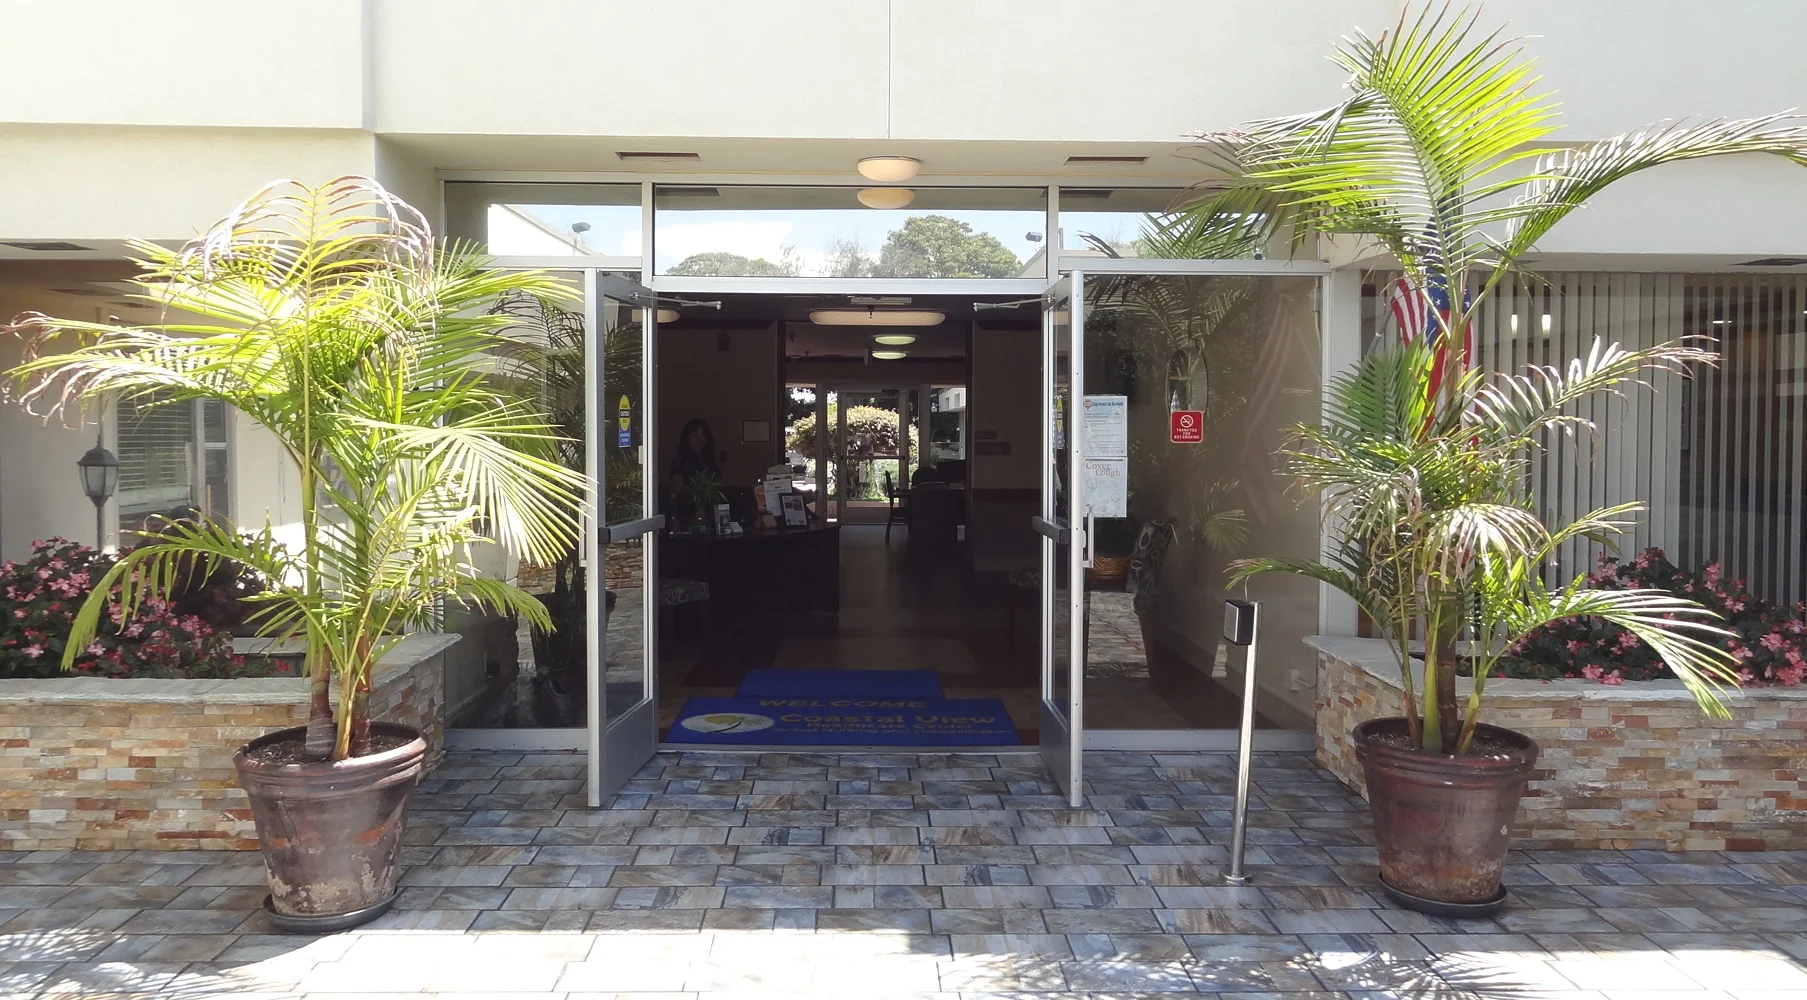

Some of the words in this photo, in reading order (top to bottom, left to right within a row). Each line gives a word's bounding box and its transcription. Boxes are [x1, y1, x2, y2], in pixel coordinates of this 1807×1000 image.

[1095, 469, 1120, 478] Cough
[759, 700, 928, 708] WELCOME
[780, 714, 904, 723] Coastal
[914, 715, 996, 723] View
